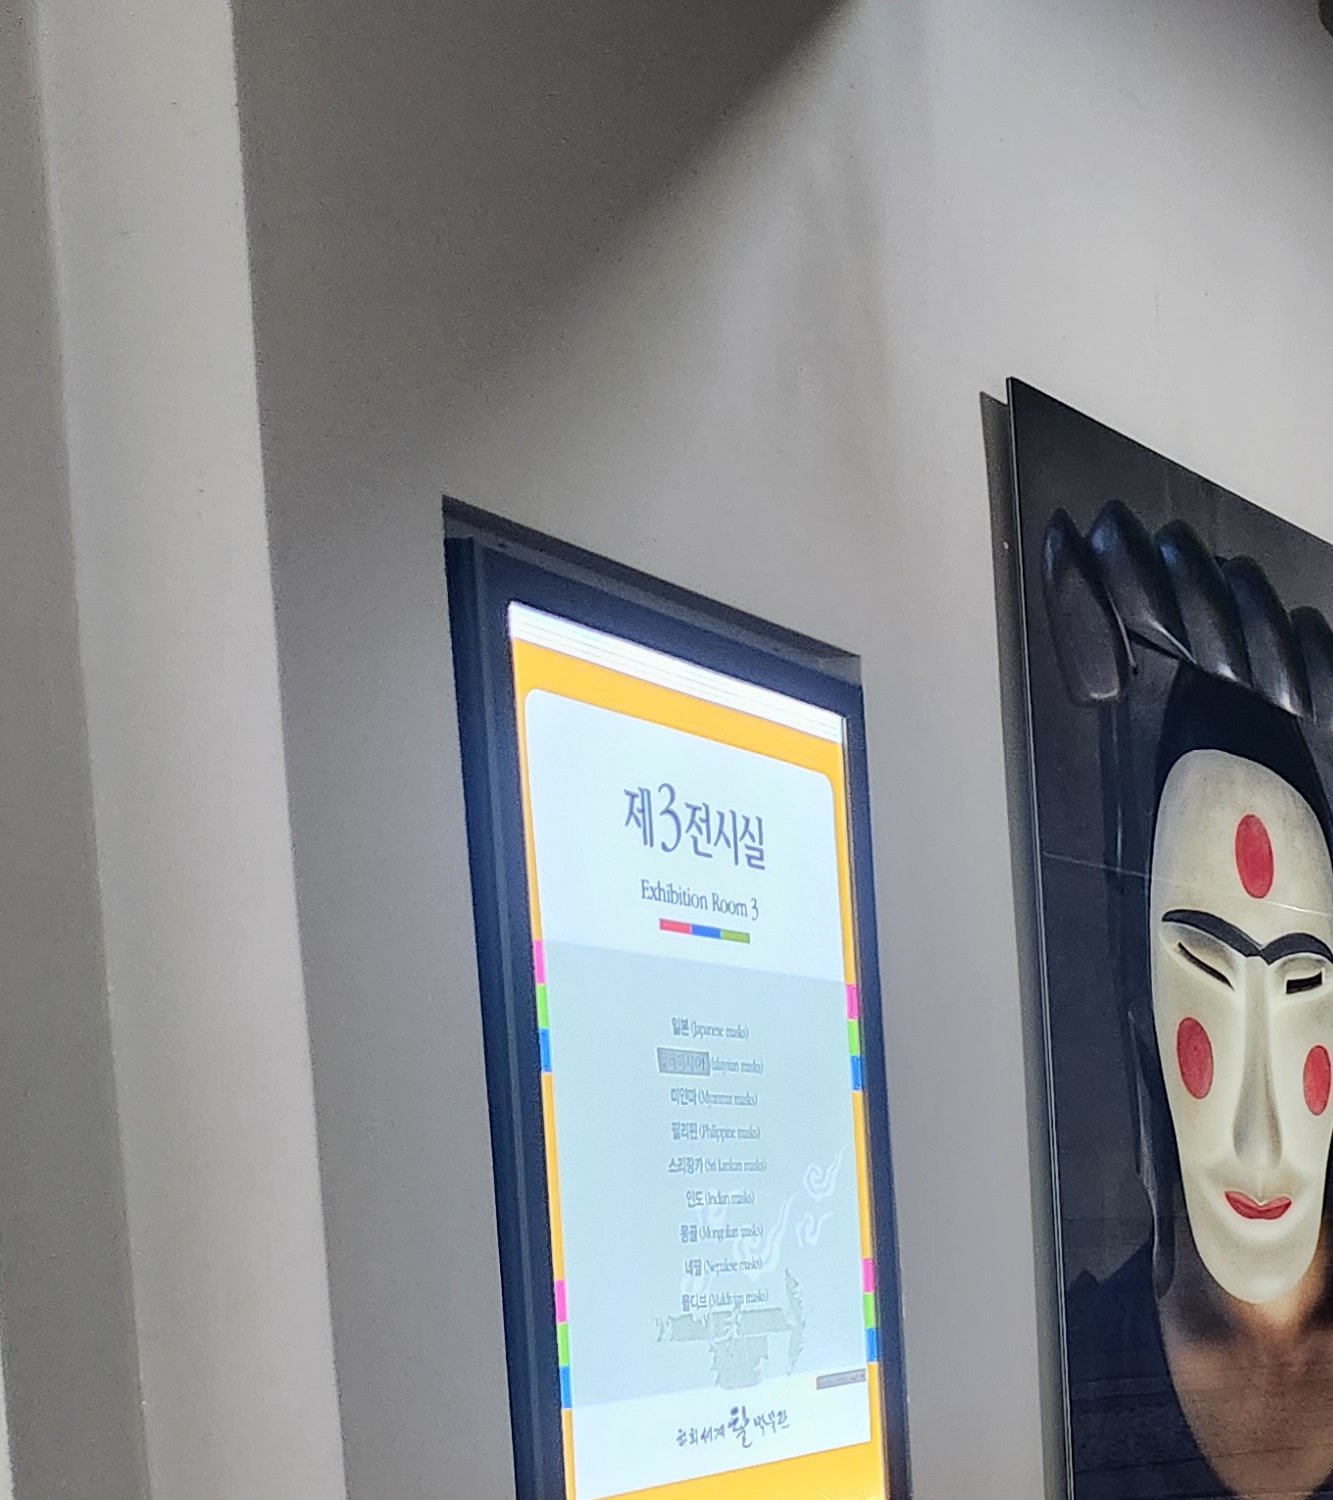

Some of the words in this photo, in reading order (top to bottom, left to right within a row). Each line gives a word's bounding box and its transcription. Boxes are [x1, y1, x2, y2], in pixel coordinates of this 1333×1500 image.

[623, 782, 766, 871] 제3전시실
[640, 878, 709, 911] Exhibition
[711, 892, 749, 918] Room
[750, 897, 760, 921] 3
[671, 1017, 690, 1036] 일본
[671, 1122, 699, 1140] 필리핀
[668, 1156, 703, 1175] 스리랑카
[686, 1189, 704, 1208] 인도
[680, 1224, 698, 1243] 몽골
